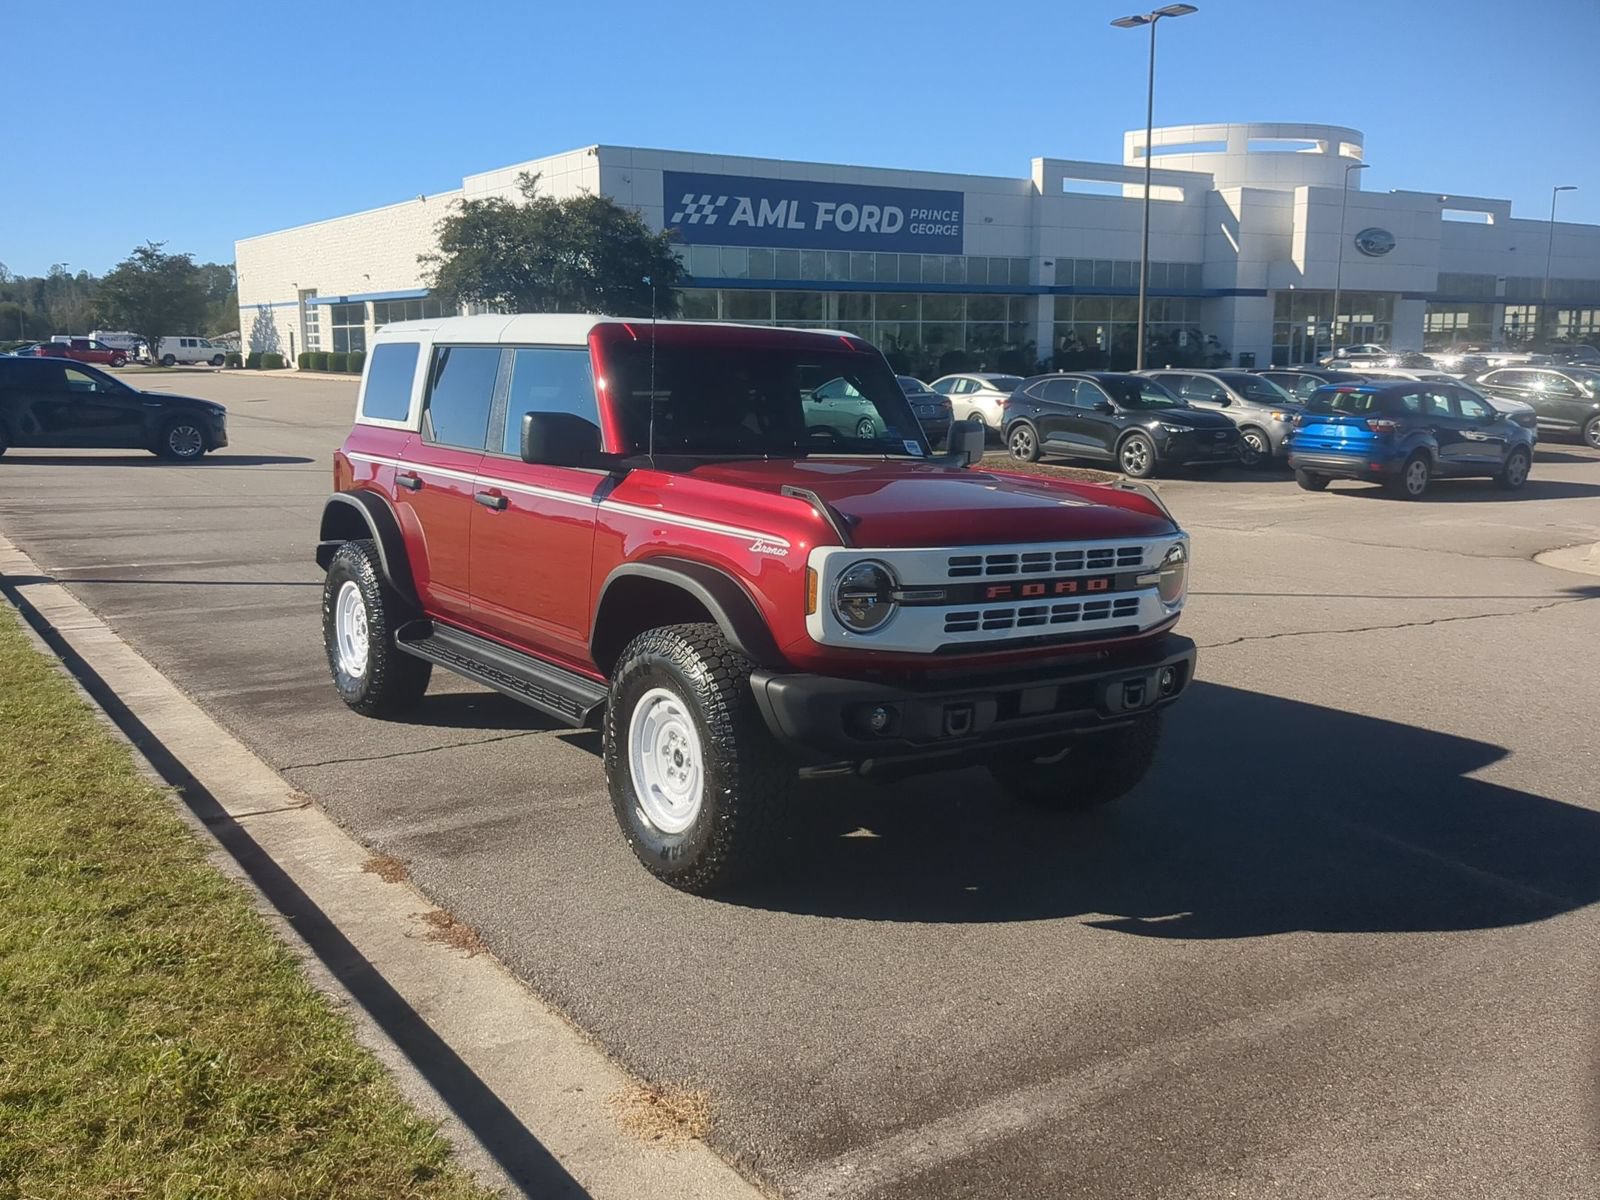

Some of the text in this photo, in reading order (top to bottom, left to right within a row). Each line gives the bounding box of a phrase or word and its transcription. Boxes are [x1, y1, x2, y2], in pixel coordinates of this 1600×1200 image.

[728, 196, 904, 234] AML FORD
[909, 208, 960, 222] PRINCE
[909, 223, 960, 236] GEORGE
[748, 538, 789, 557] Bronco
[986, 578, 1109, 599] FORD
